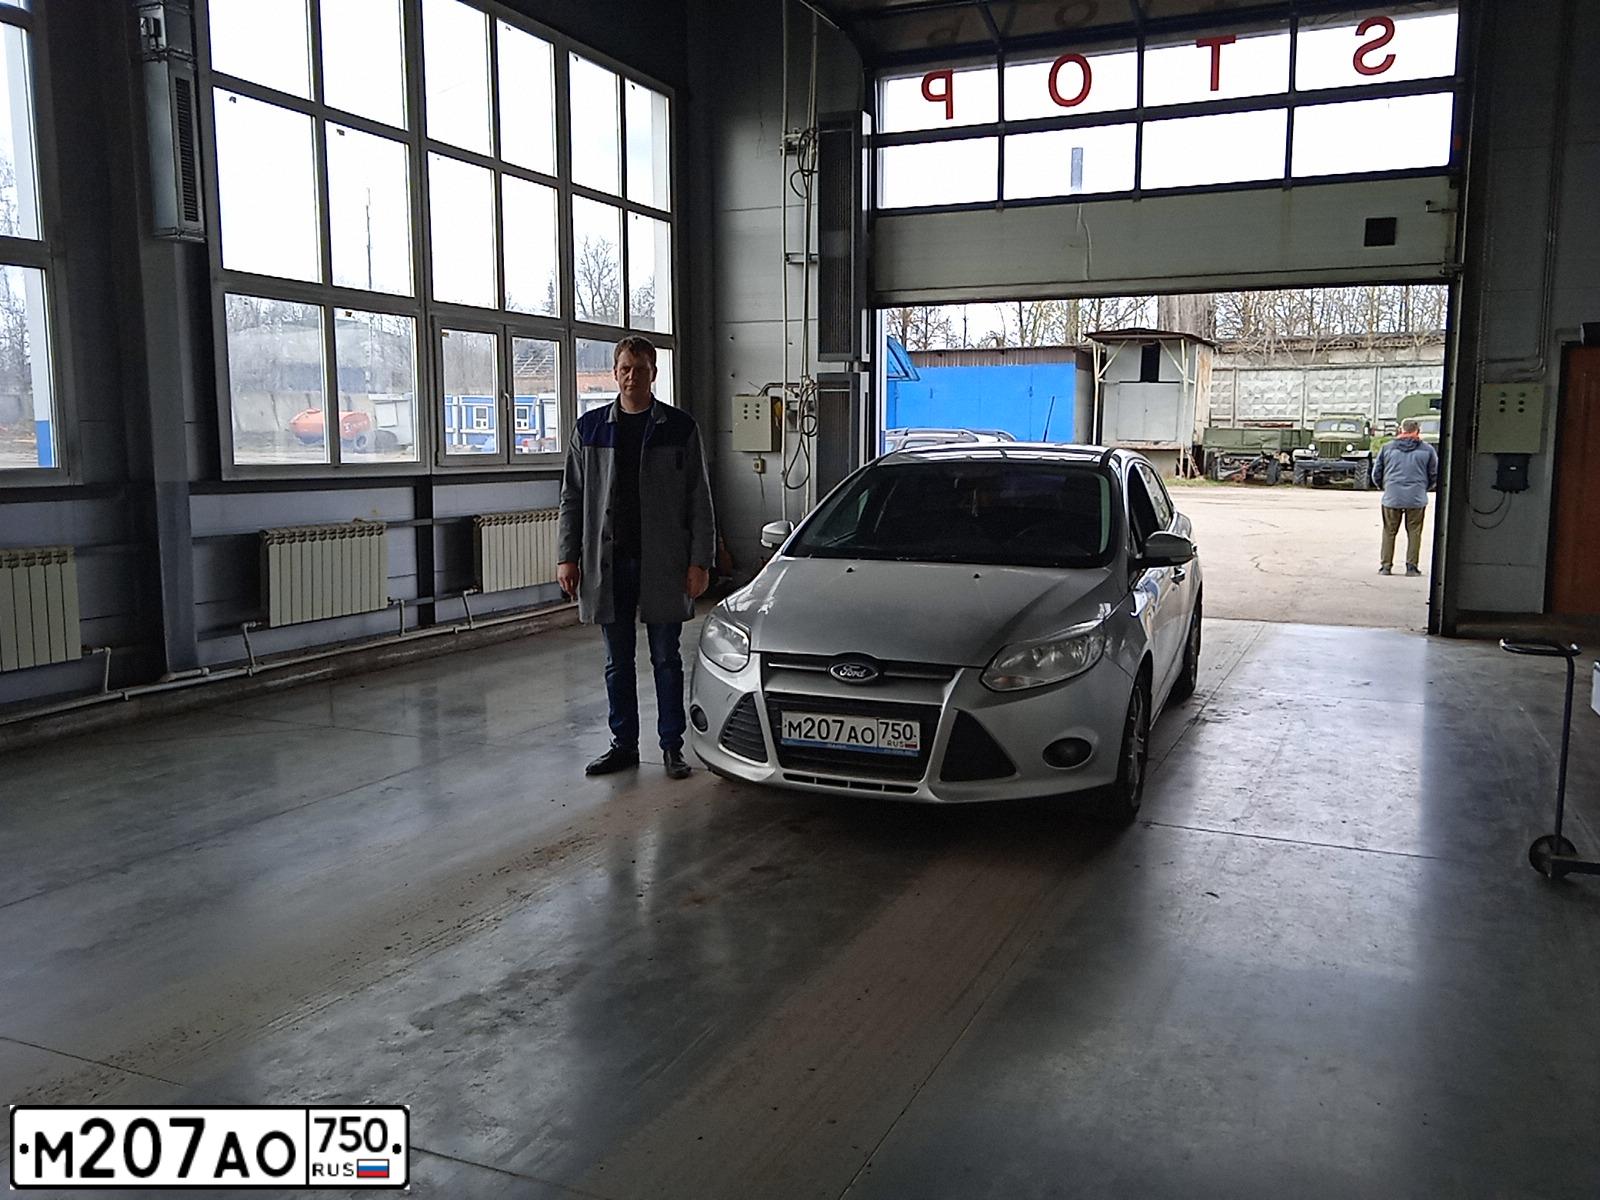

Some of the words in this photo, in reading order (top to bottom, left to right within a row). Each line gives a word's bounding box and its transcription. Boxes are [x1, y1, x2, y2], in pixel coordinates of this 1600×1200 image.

[839, 664, 867, 678] Ford
[879, 721, 914, 741] 750
[887, 740, 905, 748] RUS
